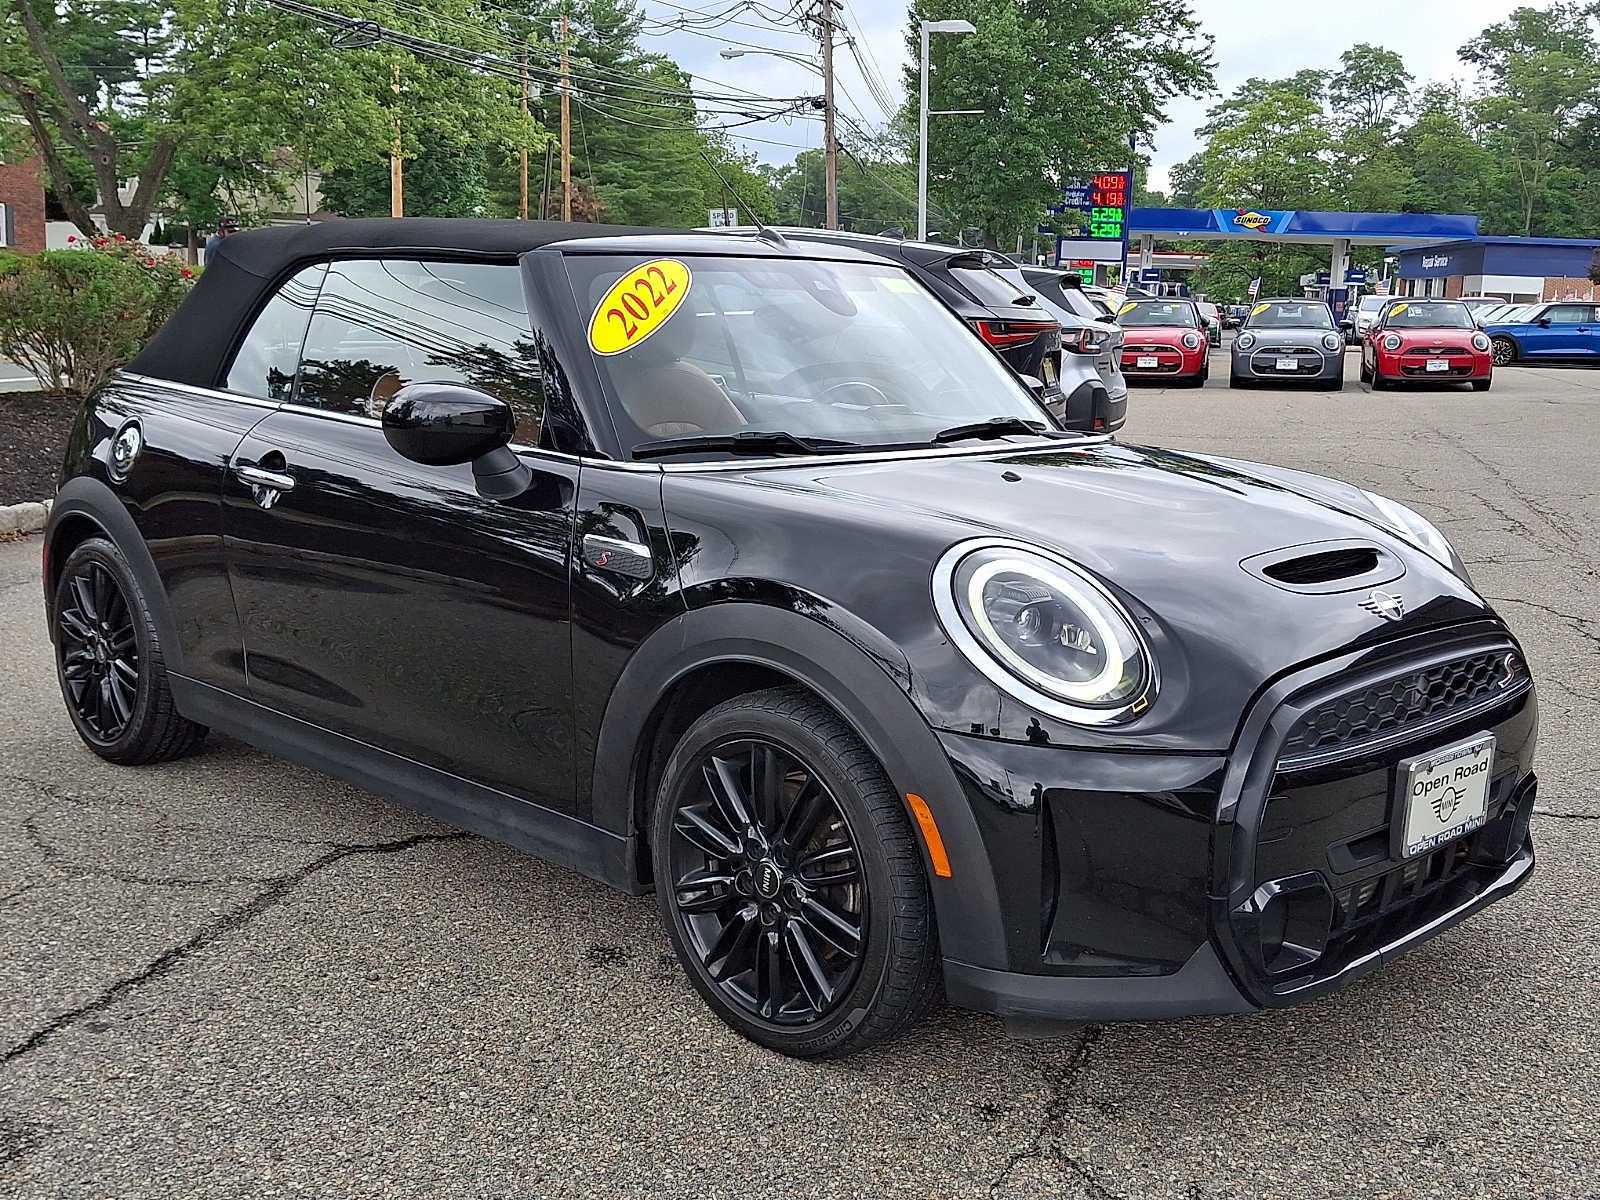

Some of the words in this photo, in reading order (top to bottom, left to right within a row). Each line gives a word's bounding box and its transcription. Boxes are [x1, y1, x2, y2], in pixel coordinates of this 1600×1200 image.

[712, 212, 735, 220] SPED
[1422, 256, 1434, 270] Repair
[1434, 254, 1449, 267] Service
[607, 266, 677, 340] 2022
[595, 551, 612, 566] S
[1498, 653, 1515, 688] S
[1413, 774, 1449, 797] Open
[1454, 757, 1488, 782] Road
[1441, 799, 1454, 811] MINI
[1409, 837, 1436, 855] OPEN
[1438, 826, 1463, 843] ROAD
[1464, 816, 1484, 833] MINI
[762, 867, 771, 892] MINI
